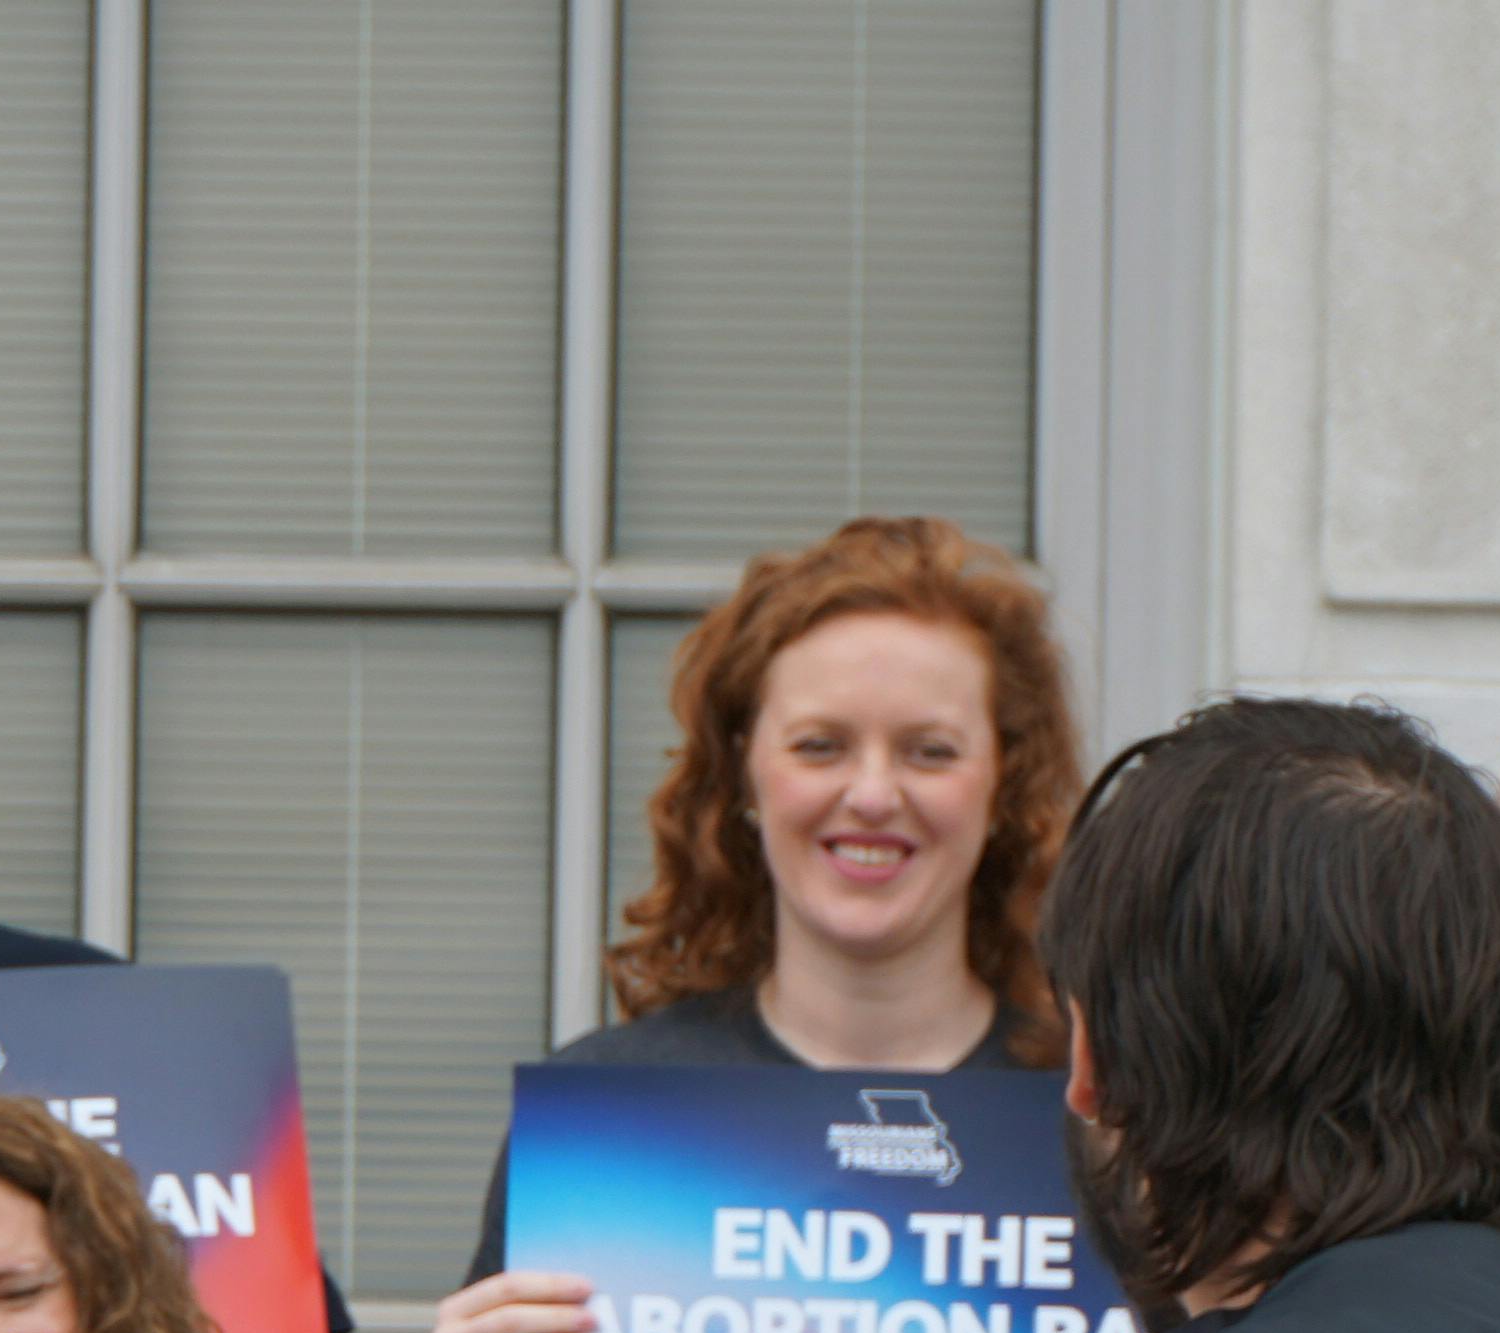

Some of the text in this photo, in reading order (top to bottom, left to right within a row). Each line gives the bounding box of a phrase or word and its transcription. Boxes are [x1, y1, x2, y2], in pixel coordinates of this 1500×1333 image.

[146, 1172, 256, 1238] AN
[712, 1206, 1076, 1290] END THE
